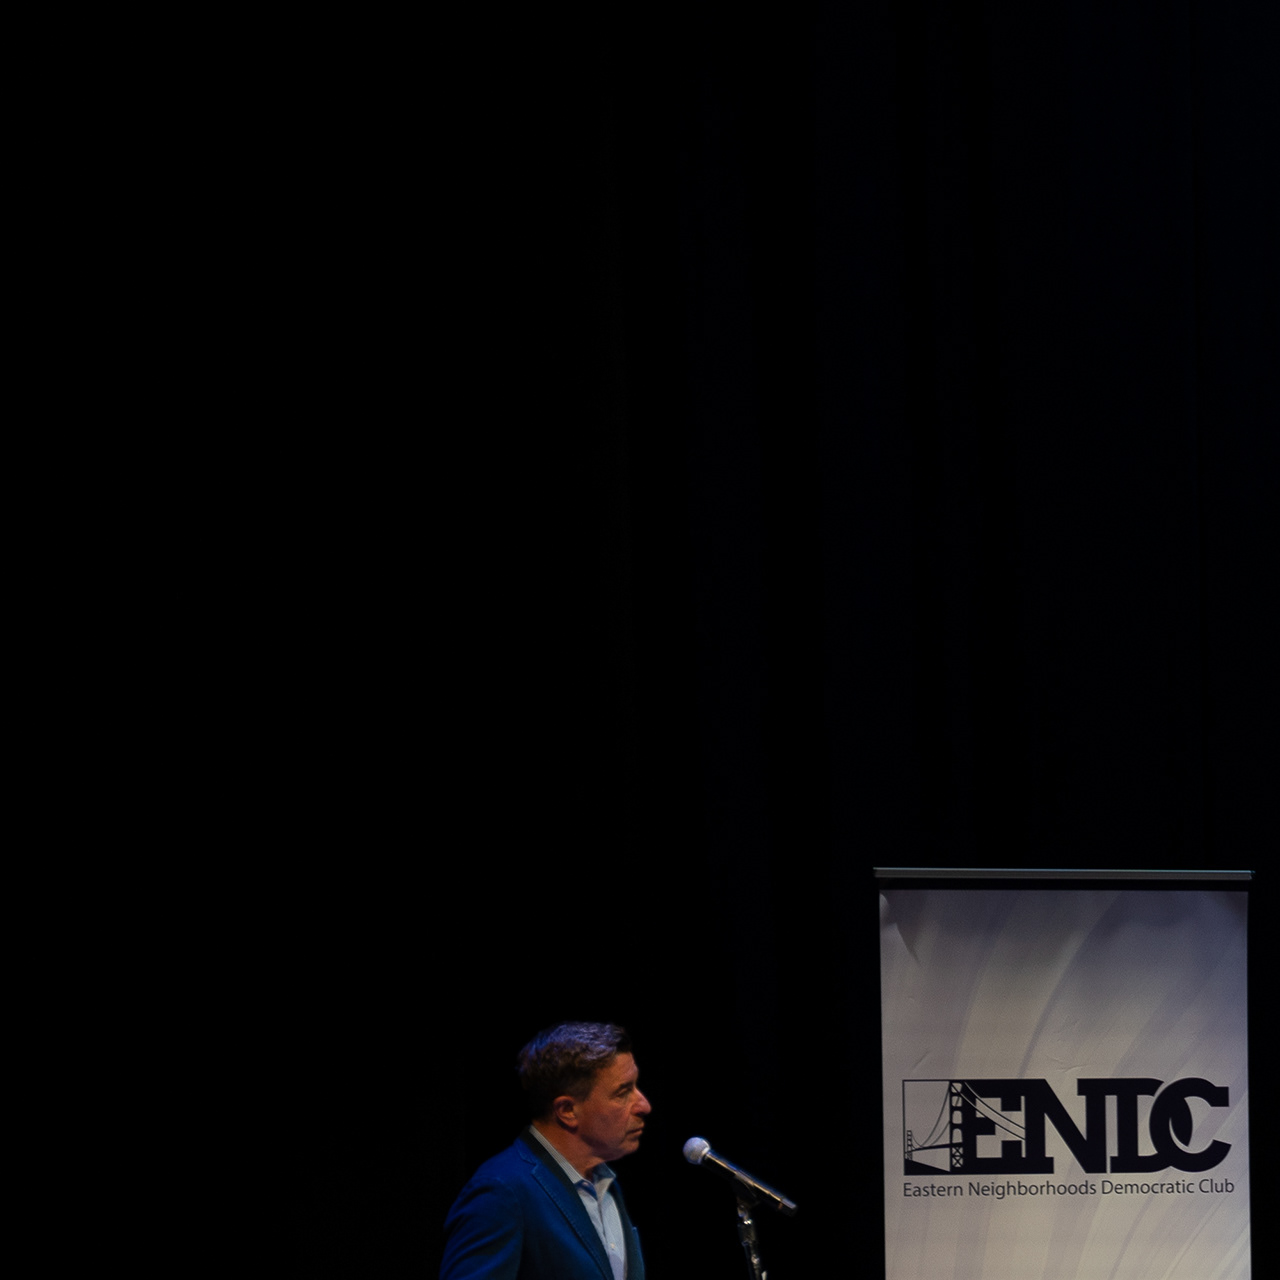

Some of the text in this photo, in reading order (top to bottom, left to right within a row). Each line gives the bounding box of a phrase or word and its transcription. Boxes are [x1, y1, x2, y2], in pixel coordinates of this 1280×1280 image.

[949, 1077, 1232, 1175] ENDC
[903, 1178, 1235, 1200] Eastern Neighborhoods Democratic Club
